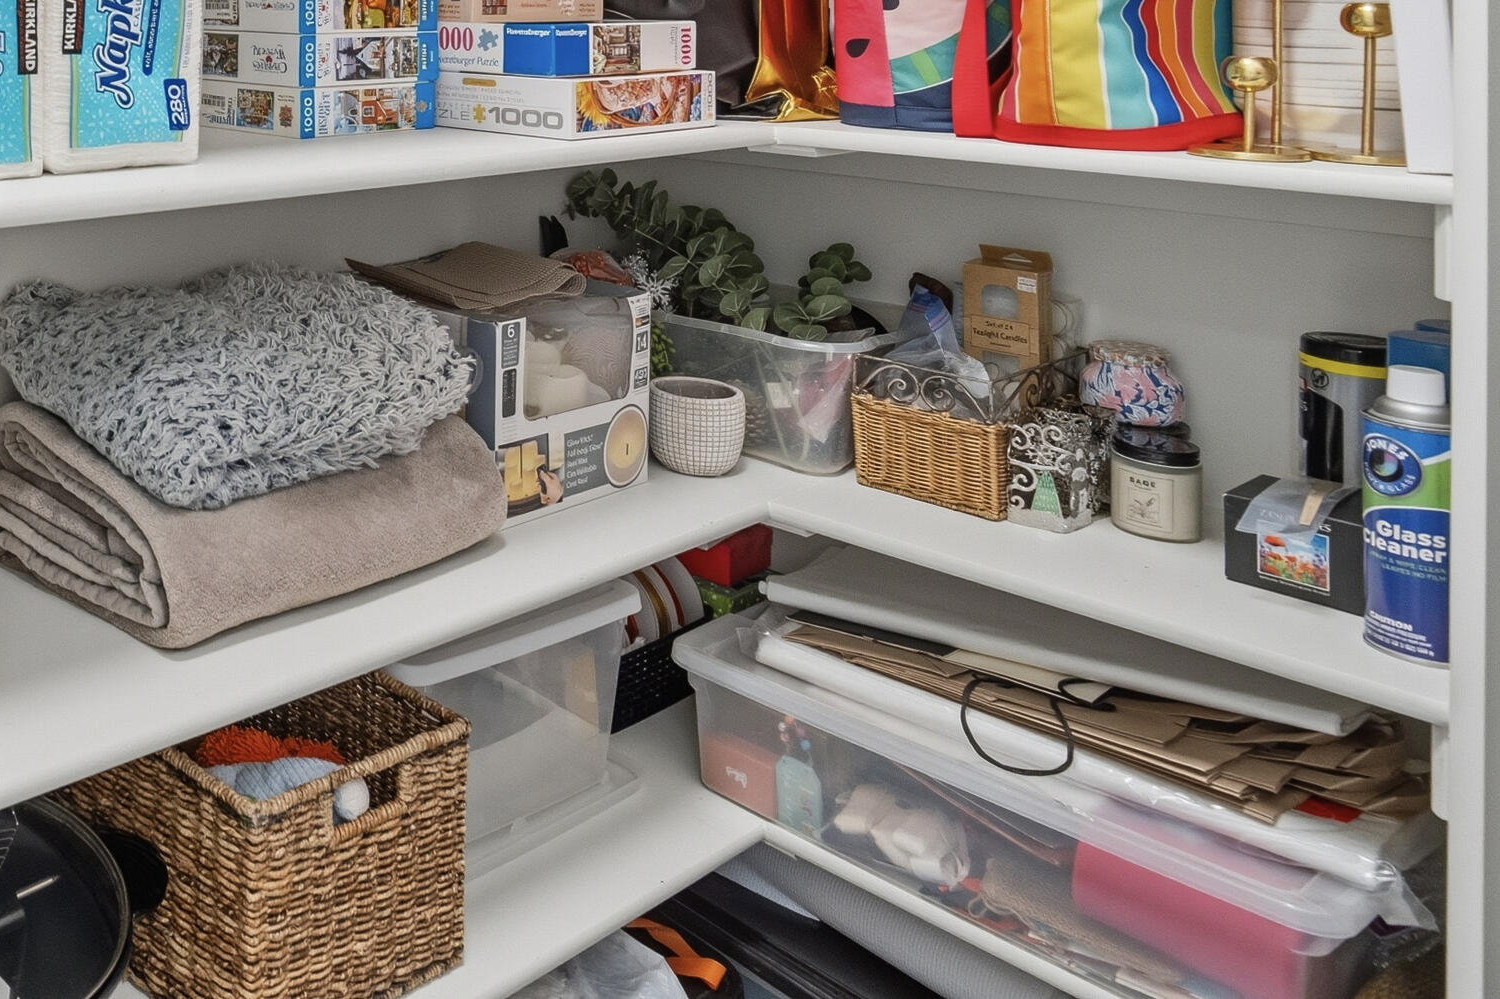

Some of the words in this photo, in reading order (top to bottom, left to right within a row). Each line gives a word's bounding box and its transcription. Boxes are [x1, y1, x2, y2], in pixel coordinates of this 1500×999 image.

[439, 26, 474, 51] 000
[680, 27, 692, 65] 1000
[168, 84, 184, 125] 280
[304, 96, 314, 133] 1000
[438, 108, 471, 121] ZLE
[488, 106, 564, 130] 1000
[507, 324, 515, 338] 6
[1363, 527, 1447, 563] Cleaner
[1376, 519, 1447, 549] Glass
